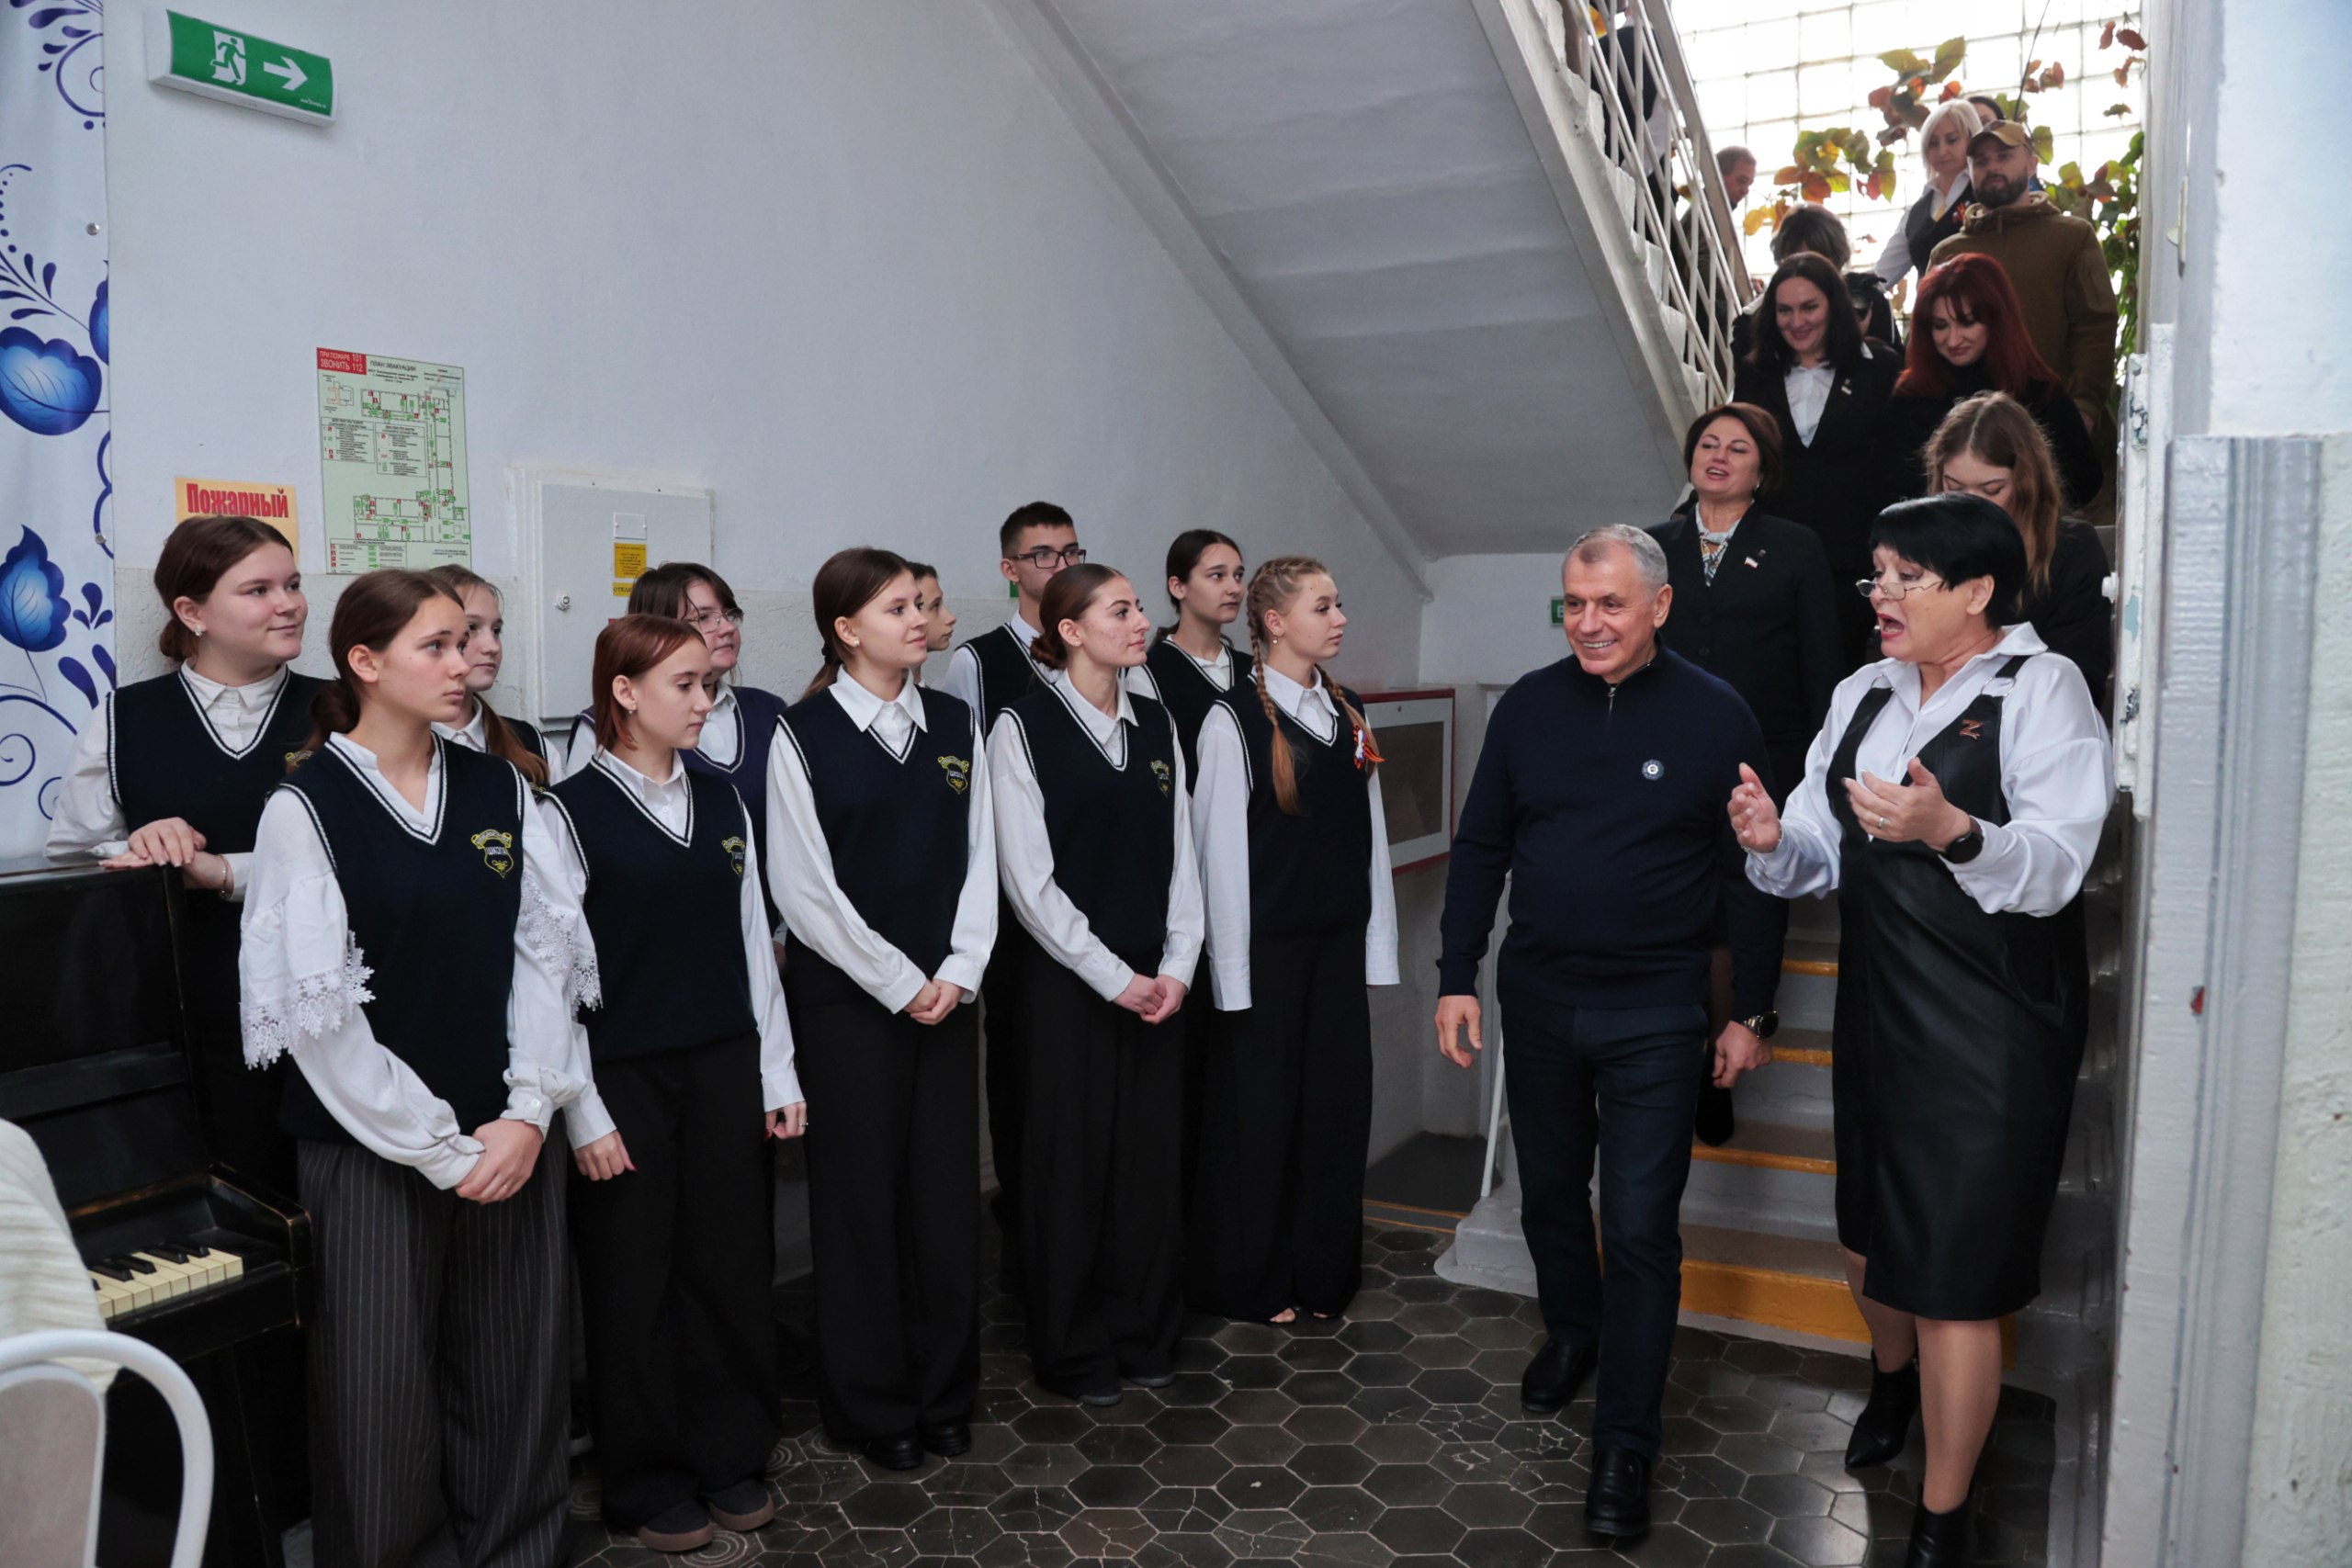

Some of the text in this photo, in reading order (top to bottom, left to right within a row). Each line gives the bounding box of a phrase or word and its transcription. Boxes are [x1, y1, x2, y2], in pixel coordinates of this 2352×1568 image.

[330, 352, 350, 361] ПОЖАРЕ
[352, 354, 363, 362] 101
[320, 358, 363, 372] ЗВОНИТЬ 112
[386, 362, 416, 371] ЭВАКУАЦИИ
[187, 483, 288, 518] Пожарный
